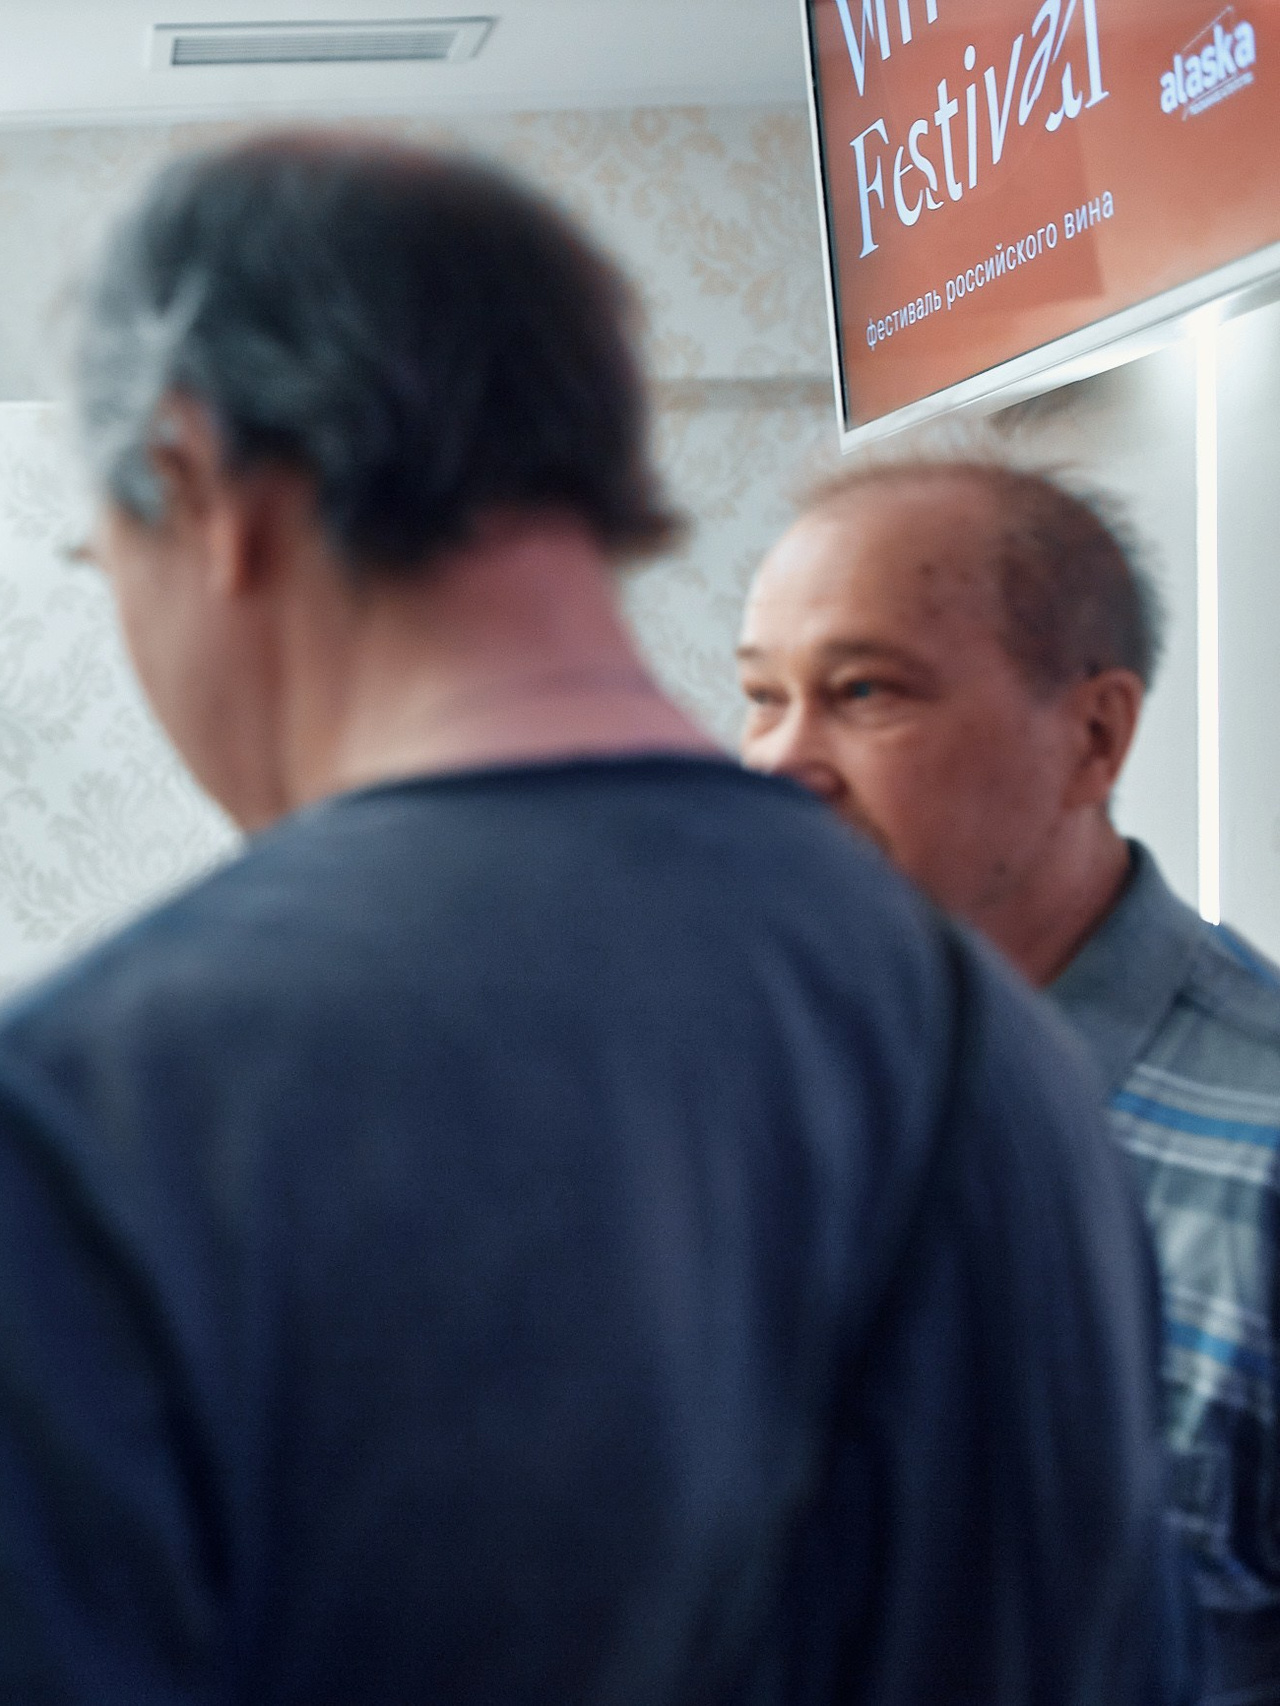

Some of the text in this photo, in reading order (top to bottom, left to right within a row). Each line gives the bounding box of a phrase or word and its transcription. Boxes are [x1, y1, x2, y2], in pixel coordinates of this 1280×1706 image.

[849, 0, 1110, 259] Festival
[1160, 19, 1257, 114] alaska
[865, 189, 1115, 351] фестиваль российского вина
